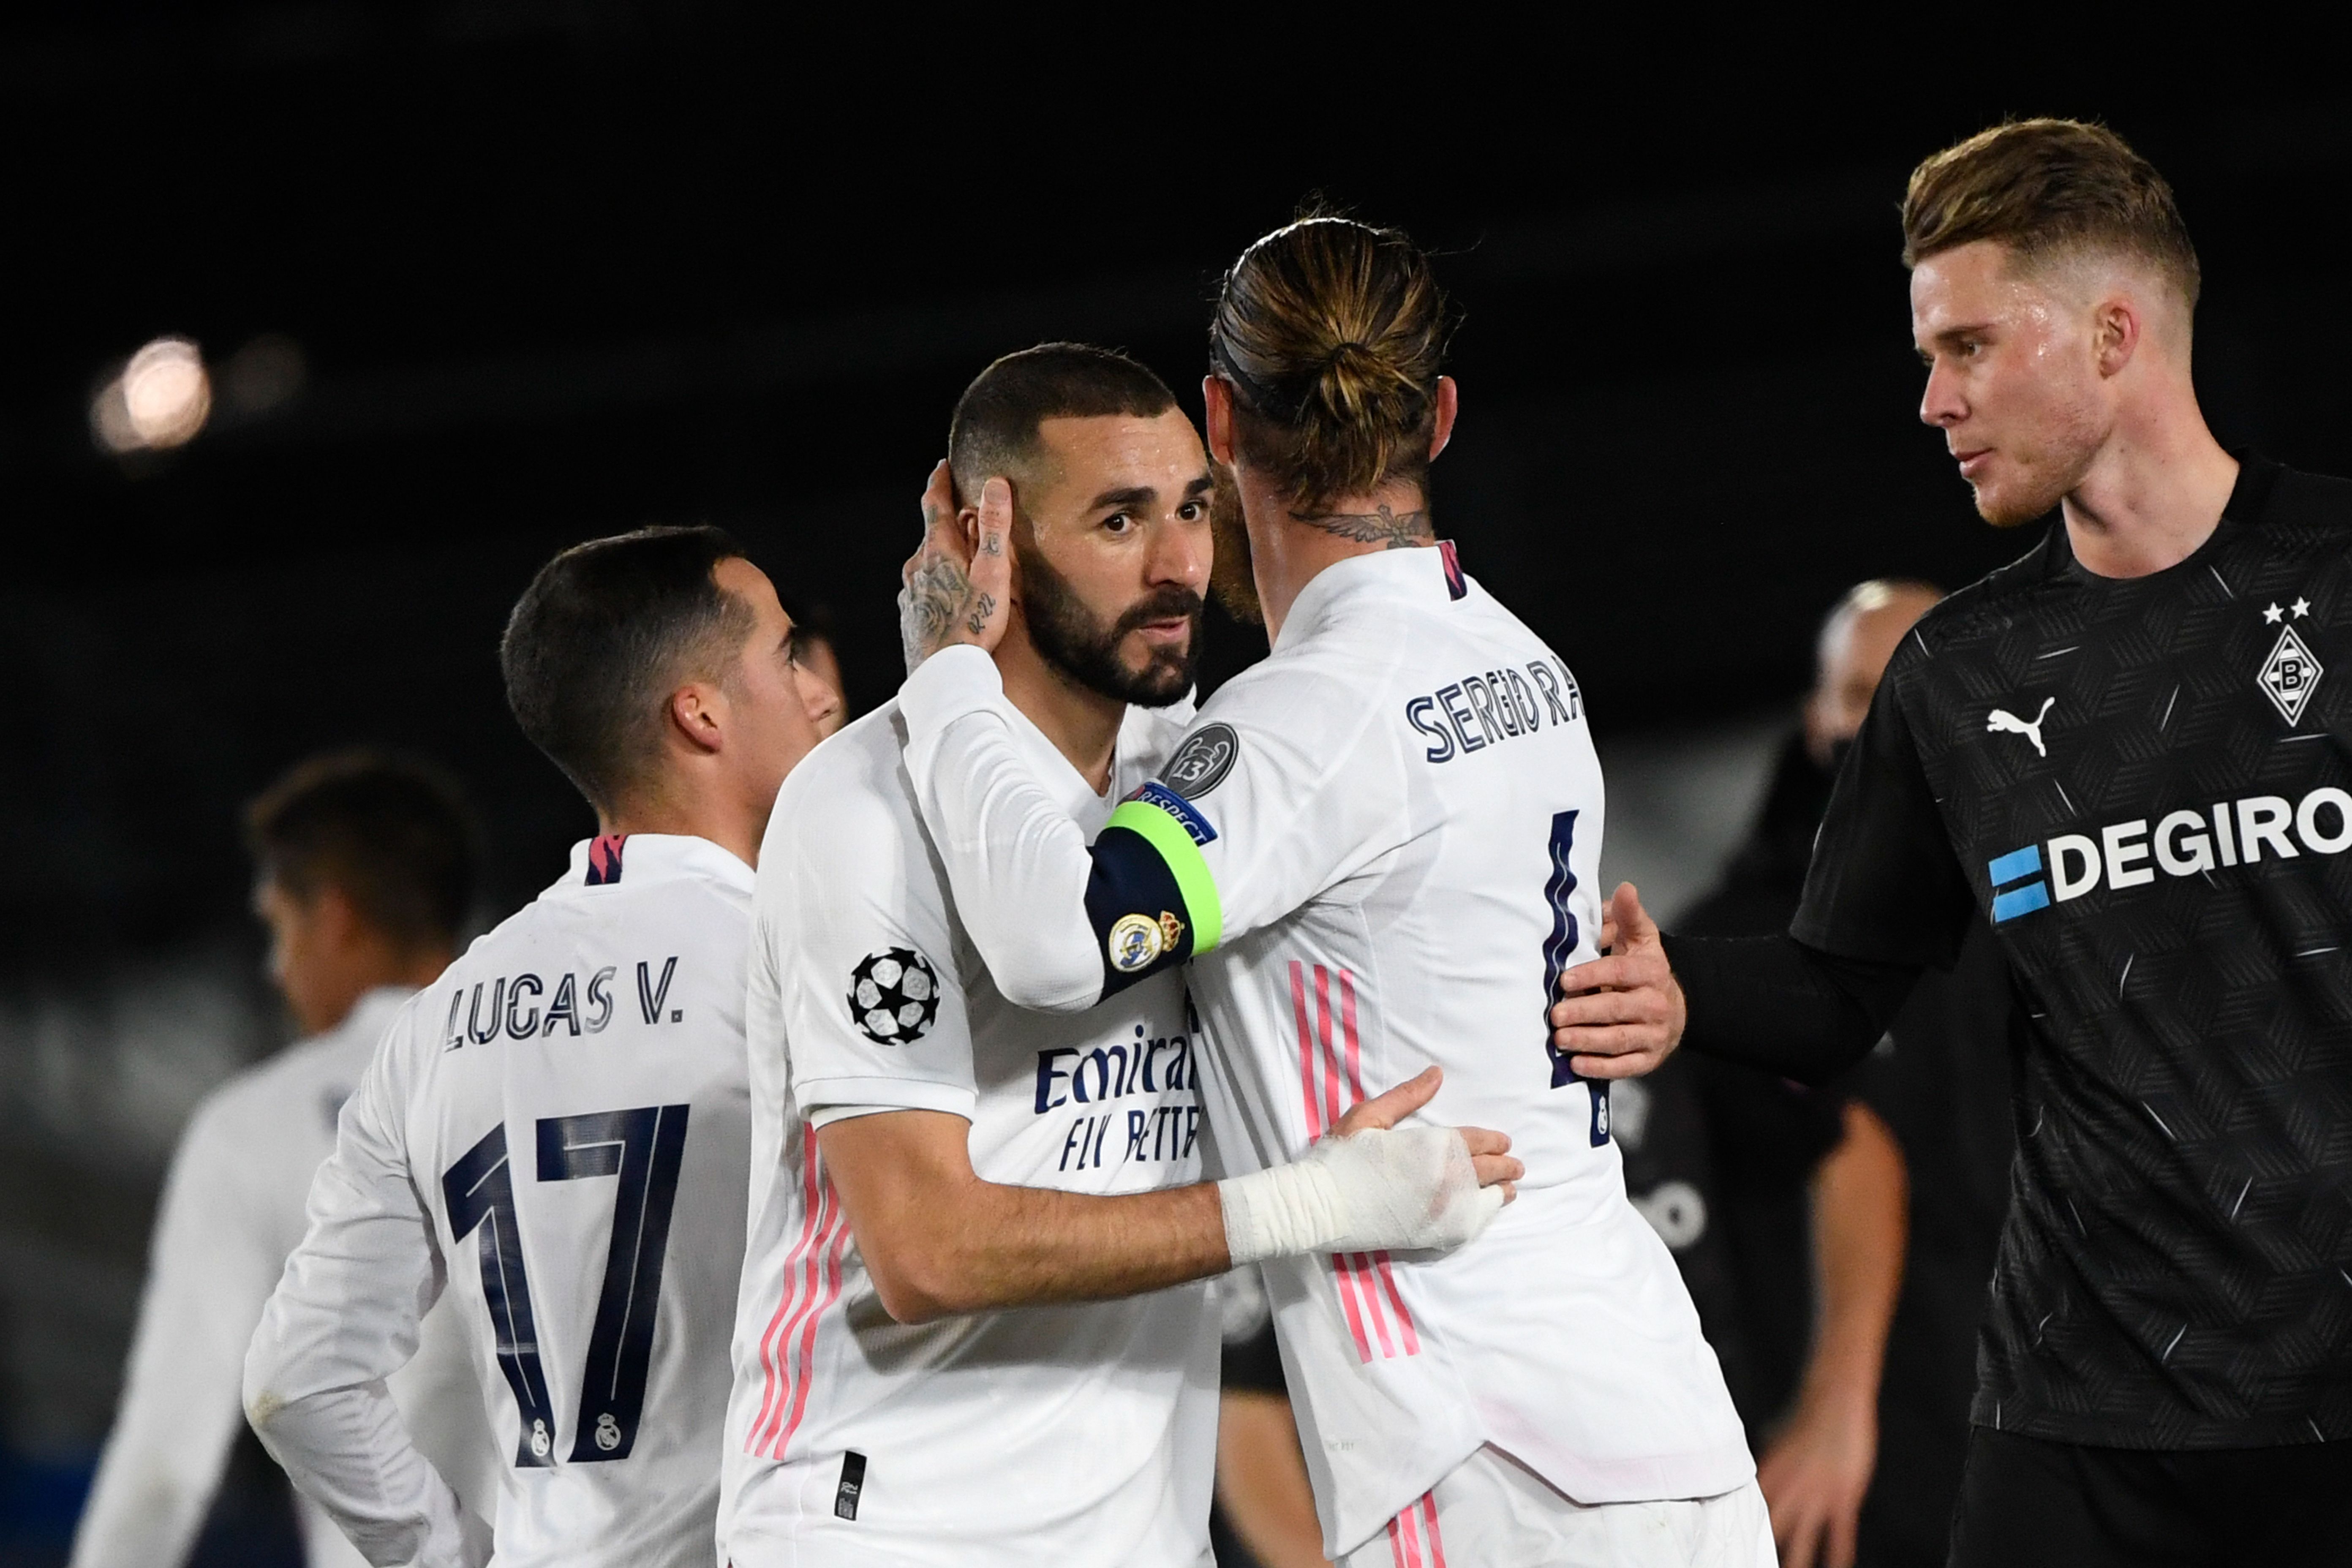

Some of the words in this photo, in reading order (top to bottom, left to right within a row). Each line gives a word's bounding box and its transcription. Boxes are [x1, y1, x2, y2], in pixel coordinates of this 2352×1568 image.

[1405, 668, 1539, 764] SERGIO
[1137, 791, 1208, 842] RESPECT
[1172, 760, 1205, 781] 13
[2047, 787, 2352, 903] DEGIRO
[444, 965, 617, 1053] LUCAS
[636, 956, 684, 1025] V.
[1058, 1113, 1112, 1172] FLY
[441, 1103, 691, 1468] 17
